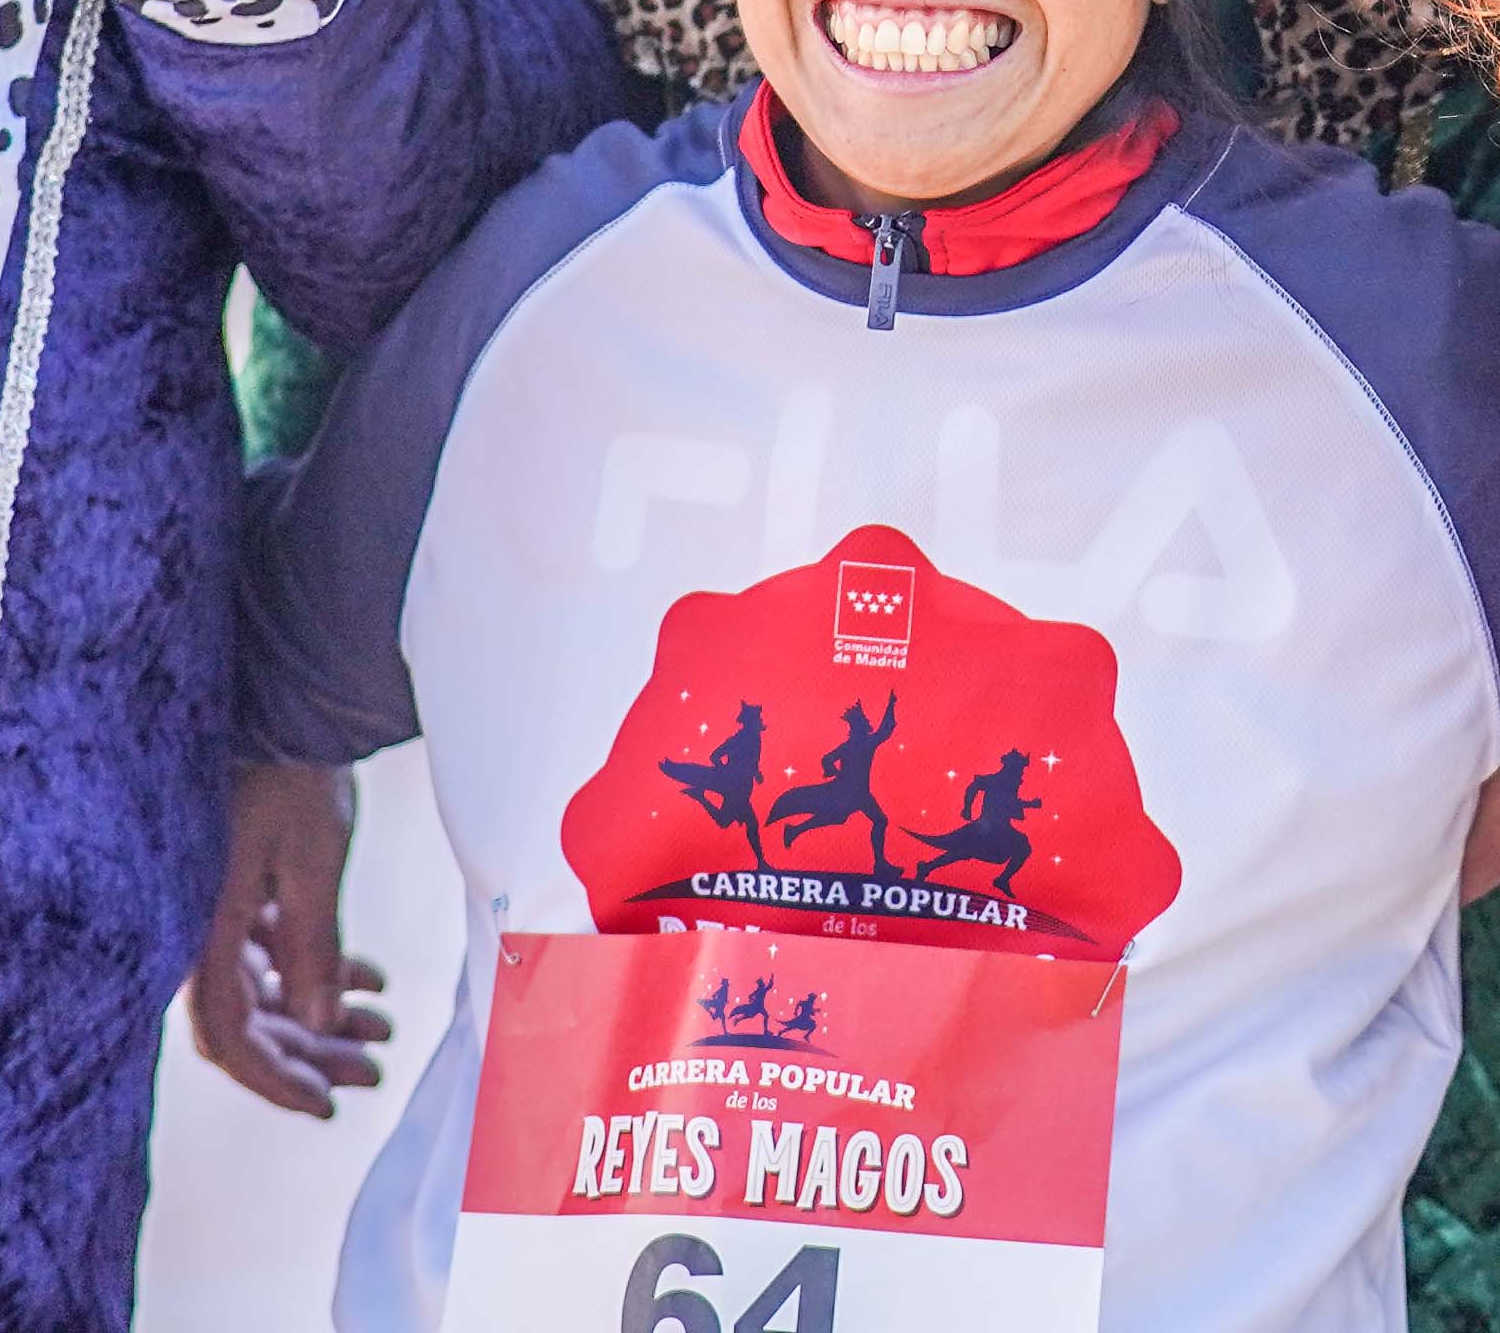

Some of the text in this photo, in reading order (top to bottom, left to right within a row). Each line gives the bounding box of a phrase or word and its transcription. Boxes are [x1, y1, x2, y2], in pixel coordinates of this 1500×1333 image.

[592, 379, 1297, 643] FILA
[833, 652, 907, 669] de Madrid
[834, 640, 908, 656] Comunidad
[691, 872, 1028, 930] CARRERA POPULAR
[822, 916, 877, 936] de los
[628, 1059, 916, 1110] CARRERA POPULAR
[725, 1092, 778, 1111] de los
[572, 1111, 969, 1218] REYES MAGOS
[620, 1233, 841, 1333] 64
